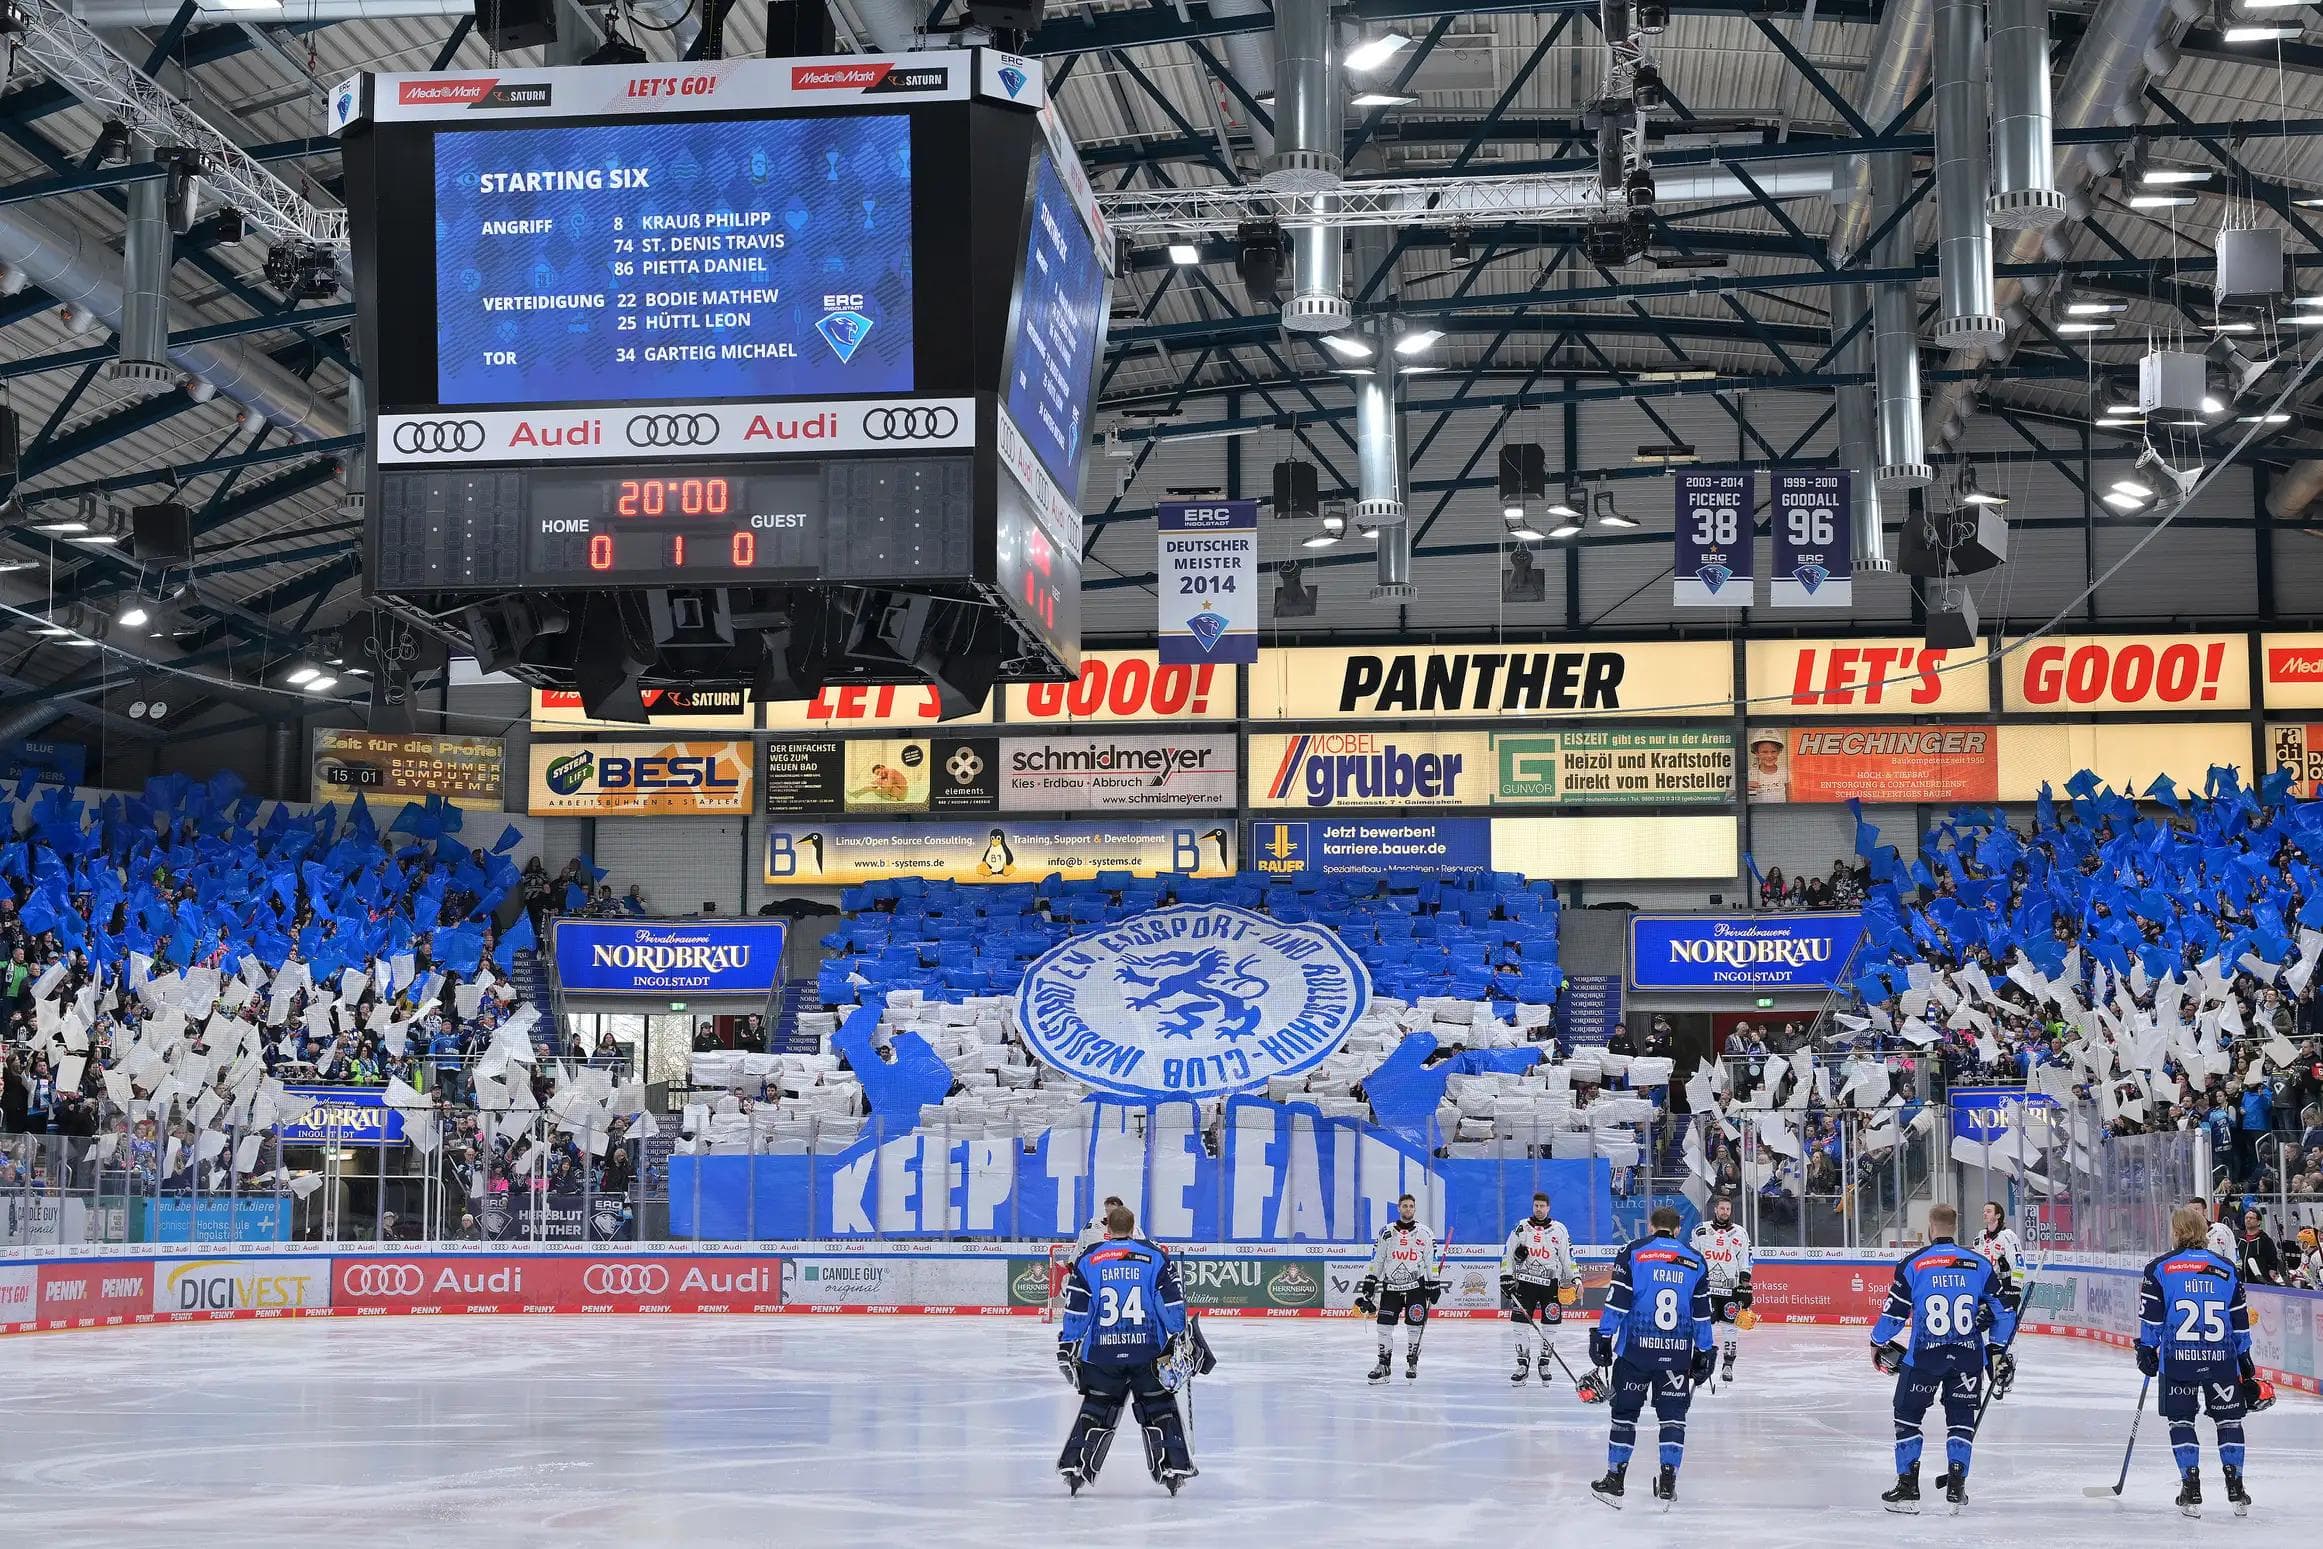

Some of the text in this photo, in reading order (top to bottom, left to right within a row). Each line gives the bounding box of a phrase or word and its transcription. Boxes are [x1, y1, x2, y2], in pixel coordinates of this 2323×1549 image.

[1001, 54, 1023, 66] ERC
[628, 76, 719, 98] LET'S GO!
[906, 73, 942, 87] SATURN
[510, 90, 545, 102] SATURN
[480, 167, 650, 194] STARTING SIX
[482, 219, 553, 236] ANGRIFF
[613, 216, 624, 231] 8
[705, 211, 771, 228] PHILIPP
[613, 233, 785, 254] 74 ST. DENIS TRAVIS
[614, 257, 767, 277] 86 PIETTA DANIEL
[483, 289, 779, 311] VERTEIDIGUNG 22 BODIE MATHEW
[823, 294, 864, 306] ERC
[617, 311, 751, 331] 25 HÜTTL LEON
[483, 343, 798, 366] TOR 34 GARTEIG MICHAEL
[743, 412, 837, 440] Audi
[509, 421, 601, 447] Audi
[1689, 493, 1741, 506] FICENEC
[1782, 493, 1840, 506] GOODALL
[750, 513, 807, 529] GUEST
[1184, 508, 1230, 521] ERC
[541, 517, 590, 534] HOME
[1692, 508, 1738, 545] 38
[1788, 508, 1834, 546] 96
[590, 535, 611, 570] 0
[673, 537, 683, 566] 1
[732, 532, 753, 567] 0
[1166, 539, 1250, 553] DEUTSCHER
[1174, 557, 1242, 570] MEISTER
[1701, 554, 1727, 562] ERC
[1797, 554, 1824, 562] ERC
[1180, 575, 1236, 595] 2014
[1791, 648, 1948, 706] LET'S
[2023, 643, 2226, 705] GOOO!
[1339, 652, 1625, 712] PANTHER
[691, 692, 740, 707] SATURN
[323, 736, 502, 758] Zeit für die Profis!
[1310, 735, 1380, 754] MÖBEL
[1564, 733, 1731, 747] EISZEIT gibt es nur in der Arena
[1798, 732, 1987, 756] HECHINGER
[26, 743, 55, 754] BLUE
[770, 743, 836, 753] DER EINFACHSTE
[770, 753, 808, 762] WEG ZUM
[1012, 744, 1212, 785] schmidmeyer
[1564, 752, 1731, 770] Heizöl und Kraftstoffe
[392, 759, 501, 772] STRÖHMER
[553, 754, 587, 779] SYSTEM
[599, 757, 738, 788] BESL
[770, 763, 817, 772] NEUEN BAD
[392, 769, 500, 782] COMPUTER
[568, 768, 588, 784] LIFT
[1011, 776, 1142, 789] Kies Erdbau Abbruch
[1306, 745, 1463, 807] gruber
[1565, 772, 1732, 790] direkt vom Hersteller
[397, 780, 495, 791] SYSTEME
[945, 787, 984, 796] elements
[1503, 783, 1552, 794] GUNVOR
[1821, 780, 1967, 789] ENTSORGUNG CONTAINERDIENST
[1102, 793, 1222, 805] www.schmidmeyer.net
[1013, 834, 1165, 845] Training, Support Development
[1323, 826, 1435, 838] Jetzt bewerben!
[836, 836, 975, 847] Linux/Open Source Consulting,
[1324, 843, 1446, 855] karriere.bauer.de
[1258, 860, 1305, 872] BAUER
[635, 929, 710, 944] Privatbrauerei
[1714, 922, 1792, 938] Privatbrauerei
[592, 944, 750, 973] NORDBRÄU
[1669, 938, 1832, 967] NORDBRÄU
[633, 976, 710, 986] INGOLSTADT
[1714, 971, 1792, 982] INGOLSTADT
[833, 1102, 1446, 1240] KEEP THE FAITH
[512, 1243, 530, 1251] Audi
[1705, 1250, 1732, 1262] swb
[432, 1266, 522, 1293] Audi
[680, 1266, 769, 1293] Audi
[822, 1267, 861, 1281] CANDLE
[1102, 1267, 1140, 1281] GARTEIG
[1932, 1274, 1966, 1288] PIETTA
[180, 1275, 311, 1309] DIGIVEST
[825, 1280, 881, 1301] original
[2185, 1279, 2215, 1294] HÜTTL
[1100, 1287, 1146, 1327] 34
[1791, 1295, 1831, 1305] Eichstätt
[1654, 1289, 1678, 1331] 8
[1925, 1294, 1974, 1336] 86
[2175, 1299, 2225, 1342] 25
[1100, 1333, 1147, 1345] INGOLSTADT
[1640, 1336, 1688, 1350] INGOLSTADT
[2176, 1349, 2225, 1362] INGOLSTADT
